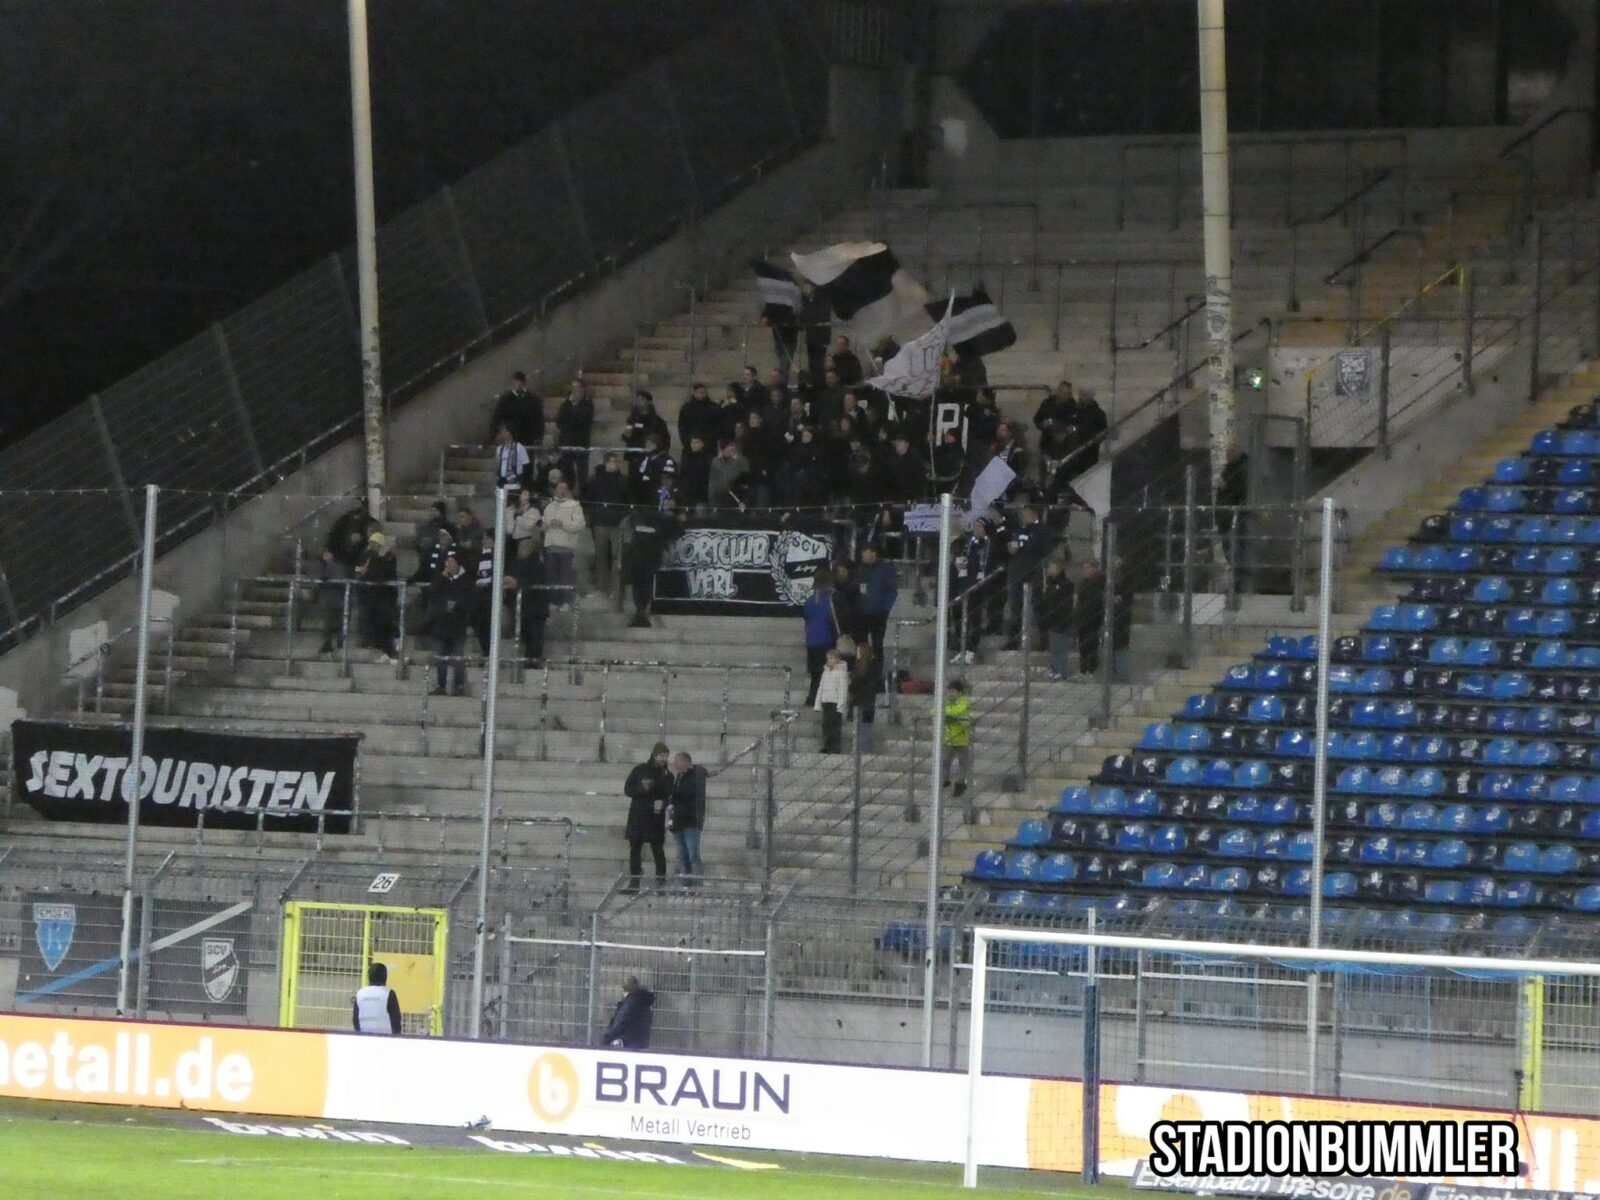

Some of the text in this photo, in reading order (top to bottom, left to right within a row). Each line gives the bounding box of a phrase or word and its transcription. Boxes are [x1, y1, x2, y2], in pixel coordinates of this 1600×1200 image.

[661, 534, 770, 567] ORTCLUB
[687, 567, 738, 598] VERL
[26, 751, 336, 816] SEXTOURISTEN
[371, 875, 396, 890] 26
[207, 945, 228, 956] SCV
[595, 1061, 790, 1114] BRAUN
[630, 1115, 752, 1141] Metall Vertrieb
